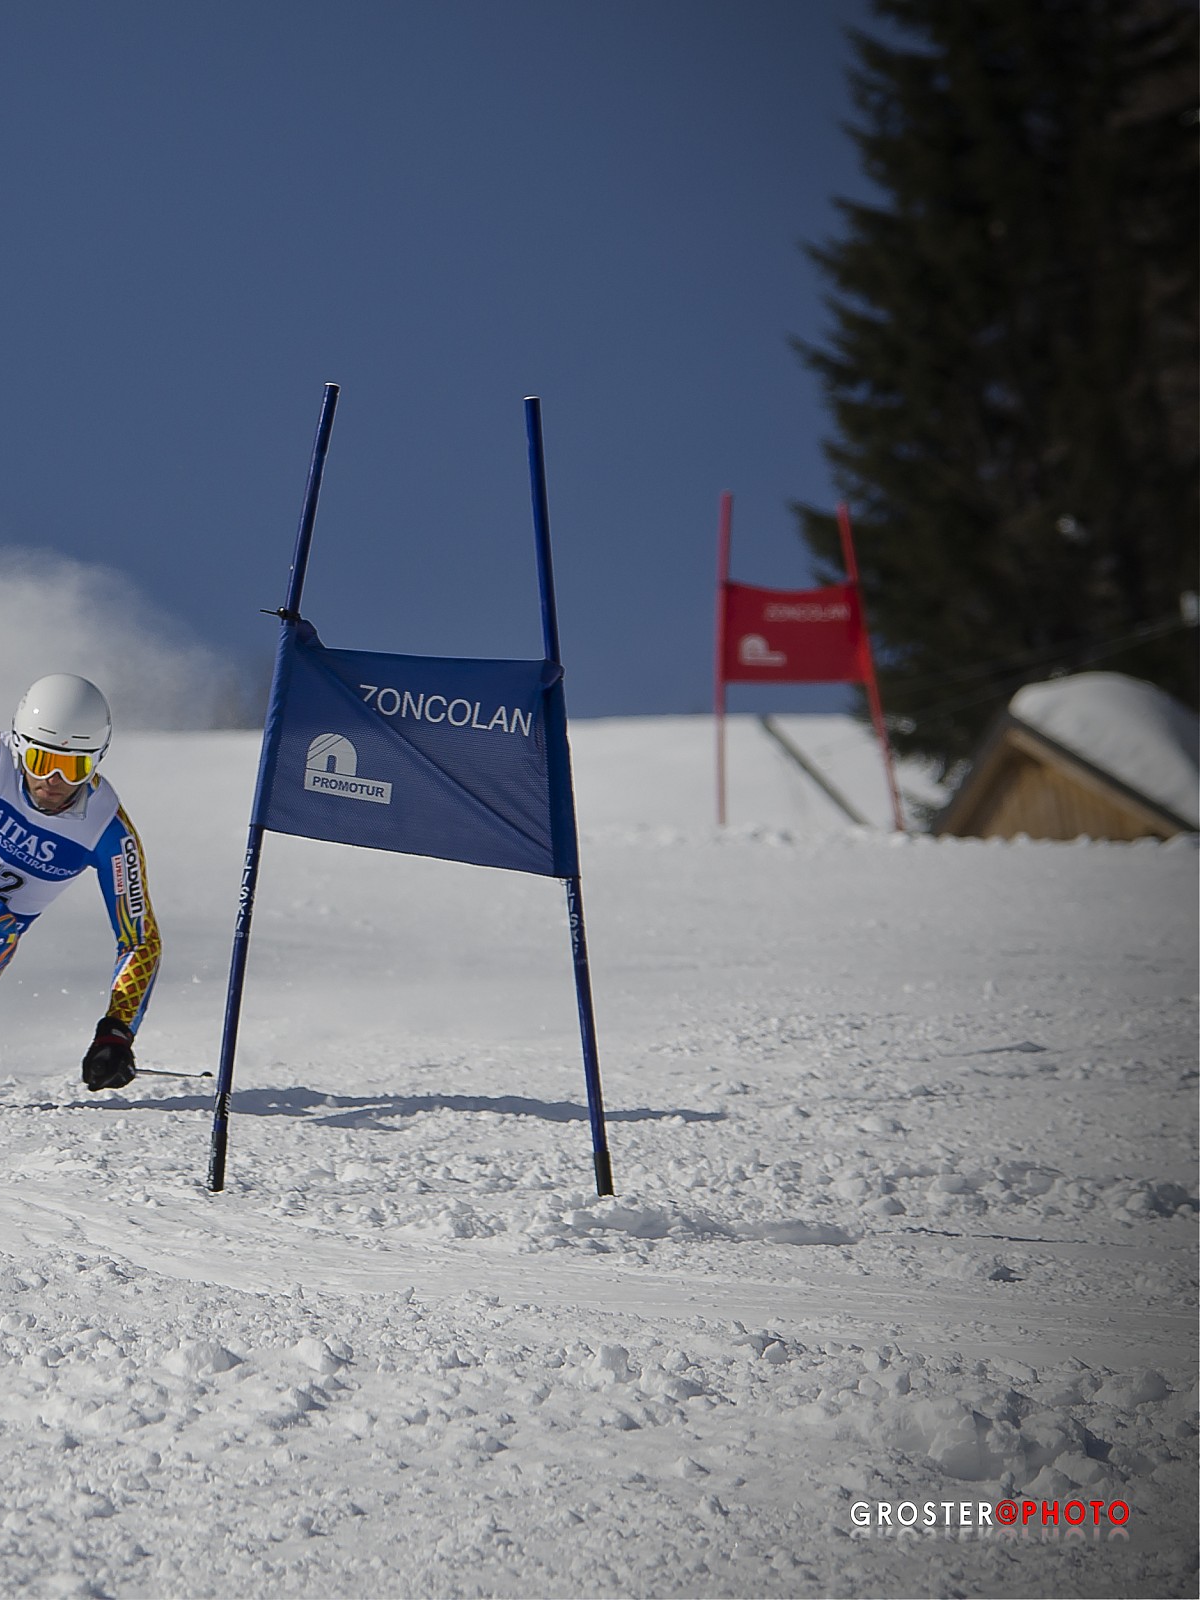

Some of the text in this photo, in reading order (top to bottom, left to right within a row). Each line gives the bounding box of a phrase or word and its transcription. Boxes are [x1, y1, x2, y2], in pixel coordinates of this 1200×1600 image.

[360, 684, 533, 737] ZONCOLAN
[312, 776, 385, 798] PROMOTUR
[0, 816, 57, 862] ITAS
[237, 855, 251, 930] LISKI
